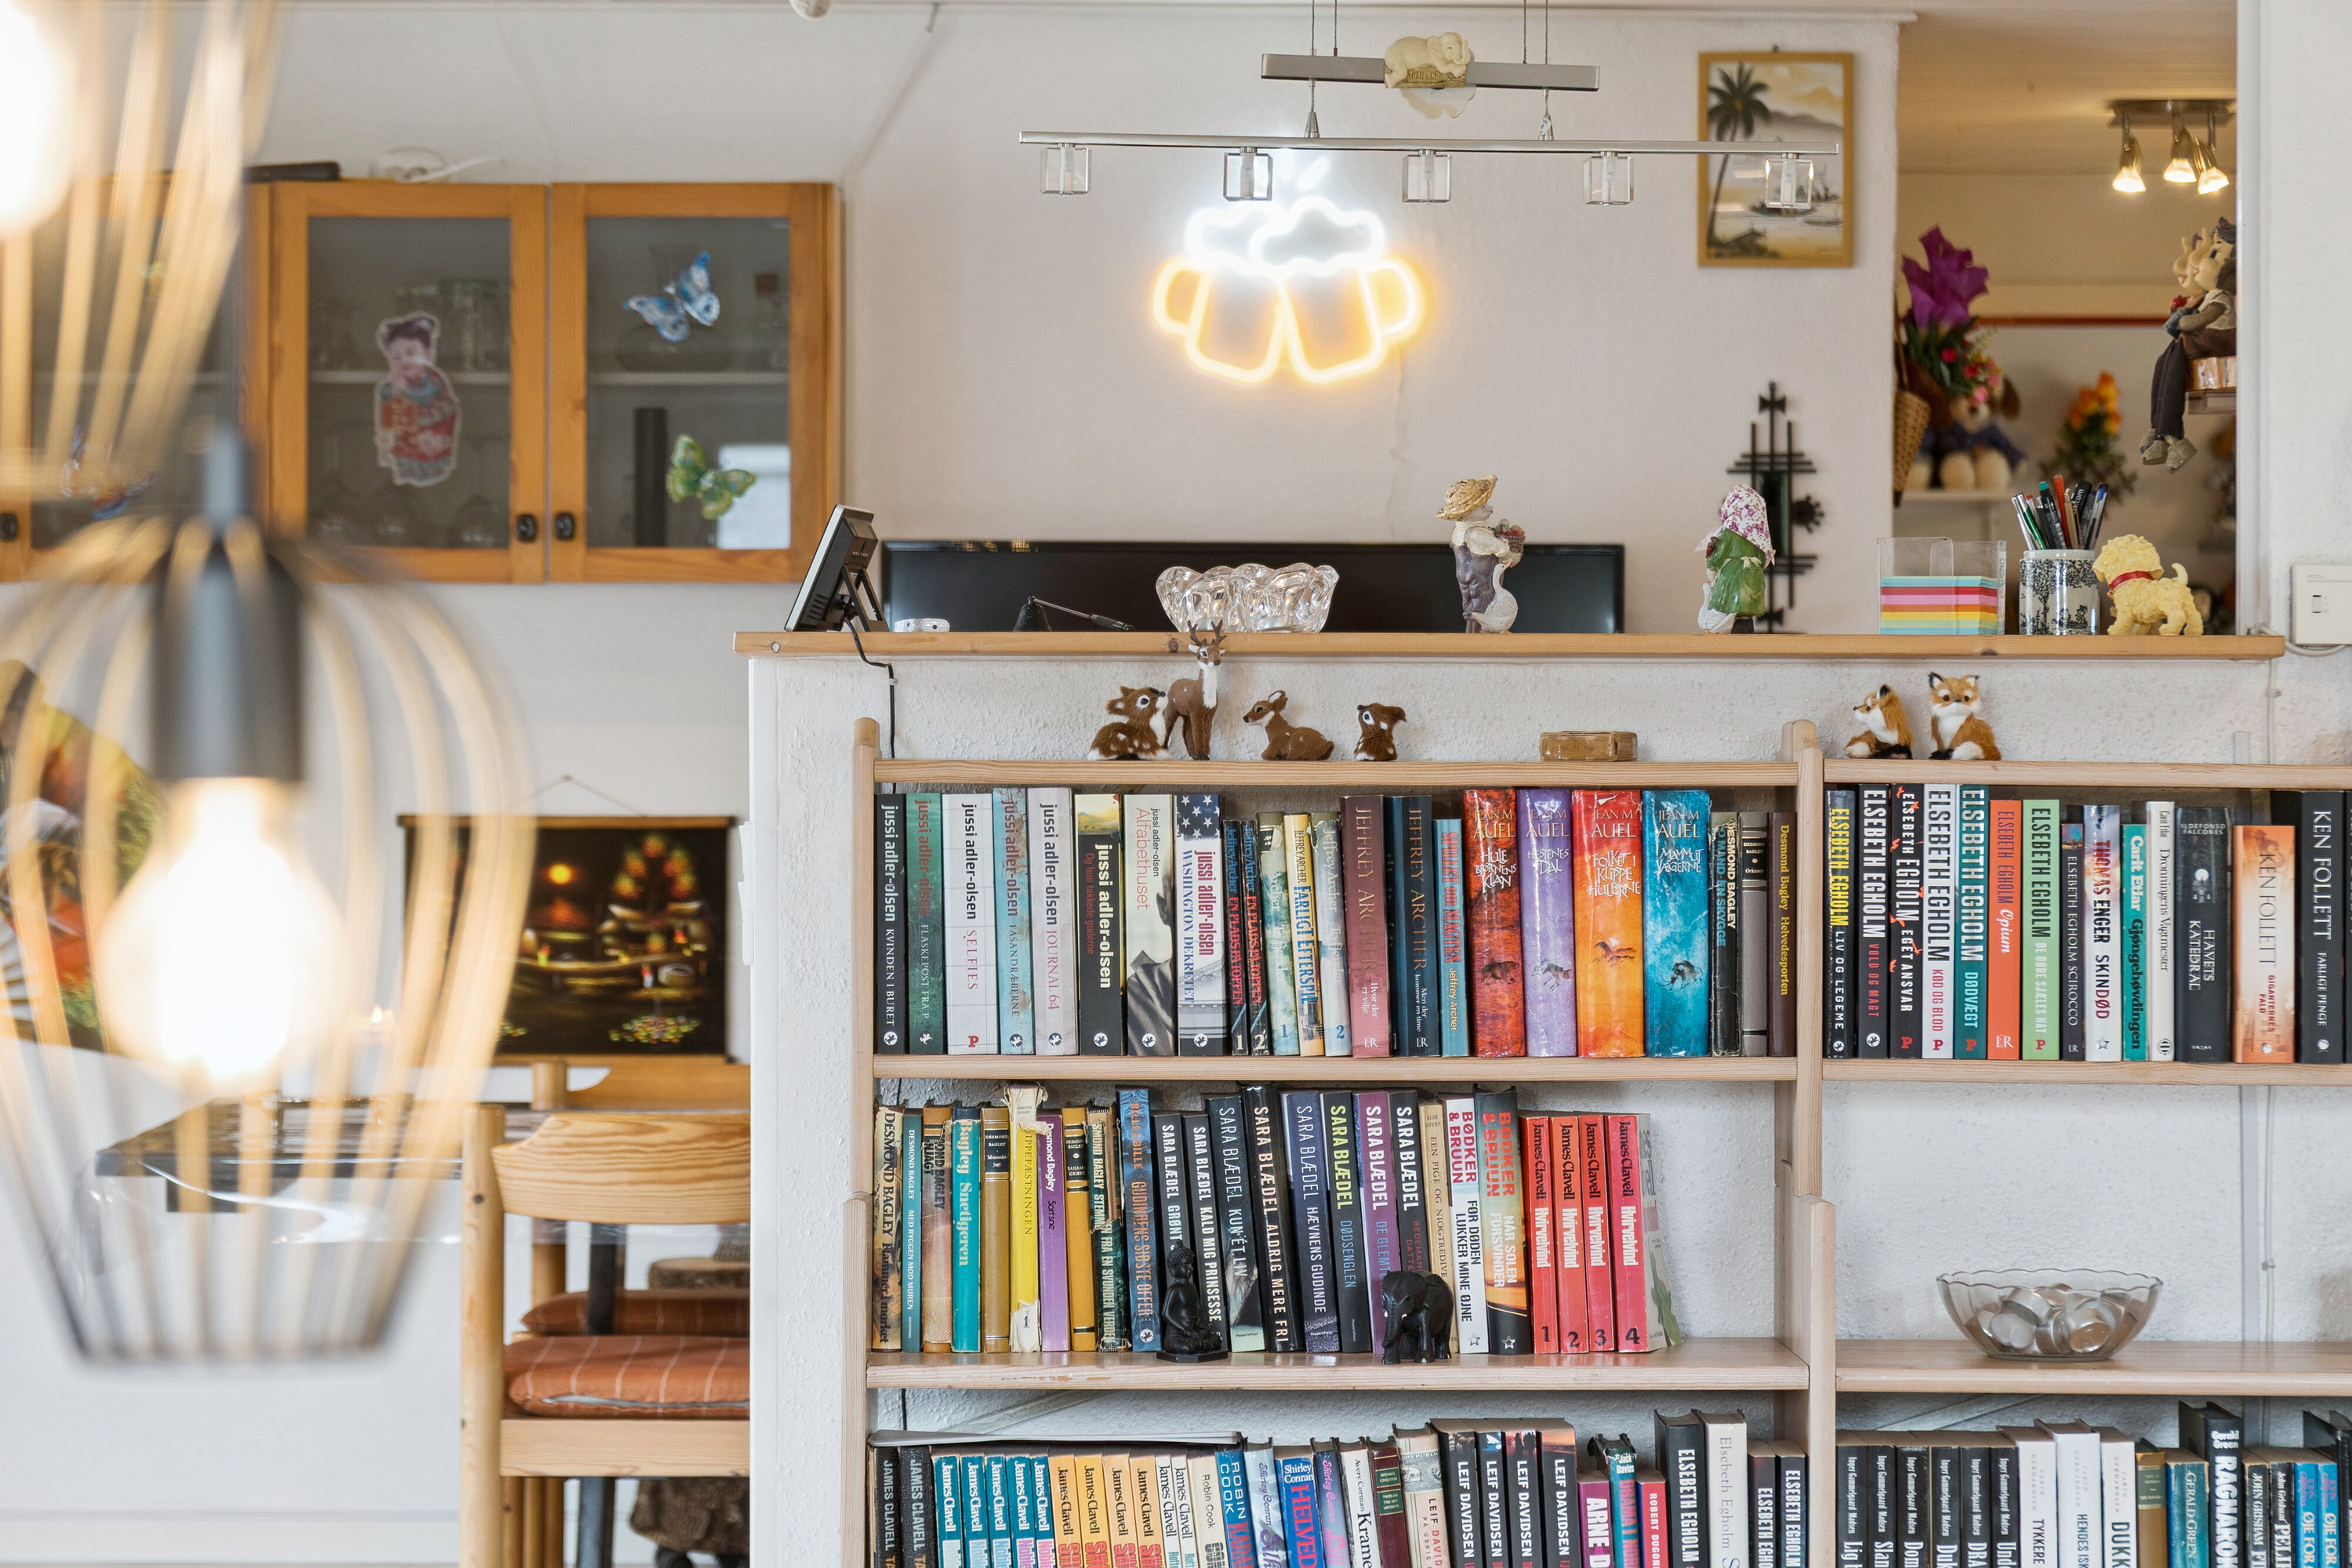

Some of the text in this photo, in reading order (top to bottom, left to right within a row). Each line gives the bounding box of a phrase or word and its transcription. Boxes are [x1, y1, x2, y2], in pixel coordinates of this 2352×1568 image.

[915, 800, 933, 916] jussi adler-olsen
[1137, 808, 1151, 909] Alfabethuset
[1474, 823, 1515, 839] AUEL
[1481, 847, 1508, 864] HULE
[1526, 822, 1569, 837] AUEL
[1527, 848, 1569, 859] HESTENES
[1592, 823, 1636, 838] AUEL
[1657, 824, 1701, 838] AUEL
[1660, 848, 1704, 862] MAMMUT
[1902, 793, 1915, 854] ELSEBETH
[881, 804, 898, 921] jussi adler-olsen
[962, 804, 978, 919] jussi adler-olsen
[1475, 863, 1516, 877] BJØRNENS
[1483, 873, 1512, 893] KLAN
[1587, 881, 1642, 898] HULERNE
[1726, 822, 1736, 928] DESMOND BAGLEY
[1831, 808, 1849, 926] ELSEBETH EGHOLM
[1863, 790, 1886, 938] ELSEBETH EGHOLM
[1896, 859, 1920, 920] EGHOLM
[1928, 790, 1951, 961] ELSEBETH EGHOLM
[1961, 789, 1984, 961] ELSEBETH EGHOLM
[2313, 810, 2332, 941] KEN FOLLETT
[1083, 853, 1095, 955] Og hun takkede guderne
[1180, 850, 1195, 1002] WASHINGTON DEKRETET
[1779, 825, 1790, 995] Desmond Bagley Helvedesporten
[2093, 840, 2111, 1019] THOMAS ENGER SKINDØD
[2259, 853, 2277, 967] KEN FOLLETT
[967, 930, 978, 989] SELFIES
[1010, 925, 1019, 1016] FASANDRÆBERNE
[1046, 930, 1060, 1010] JOURNAL 64
[1294, 885, 1319, 1005] FARLIGT EFTERSPIL
[1835, 931, 1844, 1029] LIV OG LEGEME
[1901, 930, 1913, 1011] EGET ANSVAR
[2189, 920, 2201, 991] KATEDRAL
[2204, 930, 2215, 982] HAVETS
[1449, 967, 1458, 999] Jeffrey
[1868, 944, 1879, 1018] VOLD OG MAGT
[1933, 970, 1944, 1032] KØD OG BLOD
[1965, 972, 1978, 1029] DØDVÆGT
[2128, 919, 2143, 1050] Gjøngehøvdingen
[2317, 953, 2327, 1026] FARLIGE PENGE
[1236, 1035, 1244, 1050] 1
[1254, 1034, 1265, 1050] 2
[1336, 1025, 1345, 1039] 2
[1045, 1123, 1055, 1192] Desmond Bagley
[1297, 1105, 1314, 1142] SARA
[1449, 1112, 1465, 1183] & BRUUN
[1462, 1111, 1478, 1182] BØDKER
[1498, 1112, 1516, 1196] BØDKER
[882, 1112, 895, 1237] DESMOND BAGLEY
[953, 1122, 973, 1267] Bagley Snetigeren
[1162, 1125, 1179, 1199] SARA BLÆDEL
[1300, 1147, 1319, 1200] BLÆDEL
[1530, 1123, 1551, 1269] James Clavell Hvirvelvind
[1559, 1123, 1580, 1269] James Clavell Hvirvelvind
[1618, 1120, 1639, 1266] James Clavell Hvirvelvind
[1193, 1127, 1221, 1322] SARA BLÆDEL KALD MIG PRINSESSE
[1254, 1107, 1288, 1342] SARA BLÆDEL ALDRIG MERE FRI
[1306, 1207, 1322, 1261] HÆVNENS
[1340, 1220, 1356, 1288] DØDSENGLEN
[1468, 1200, 1482, 1265] FØR DØDEN
[1490, 1212, 1505, 1288] FORSVINDER
[1311, 1265, 1327, 1313] GUDINDE
[1455, 1213, 1472, 1322] LUKKER MINE ØJNE
[1541, 1326, 1550, 1342] 1
[1568, 1331, 1580, 1348] 2
[1595, 1329, 1607, 1346] 3
[1626, 1327, 1640, 1345] 4
[2211, 1431, 2239, 1440] Gerald
[2213, 1440, 2238, 1449] Green
[884, 1460, 895, 1550] JAMES CLAVELL
[909, 1459, 925, 1551] JAMES CLAVELL
[942, 1462, 956, 1532] James Clavell
[1034, 1461, 1050, 1531] James Clavell
[1221, 1464, 1234, 1514] COOK
[1231, 1461, 1246, 1519] ROBIN
[1458, 1461, 1475, 1558] LEIF DAVIDSEN
[1486, 1461, 1502, 1557] LEIF DAVIDSEN
[1517, 1461, 1533, 1557] LEIF DAVIDSEN
[1586, 1497, 1610, 1548] ARNE
[1649, 1493, 1660, 1530] ROBERT
[1678, 1449, 1700, 1563] ELSEBETH EGHOLM
[1719, 1436, 1733, 1548] Elsebeth Egholm
[1784, 1470, 1801, 1566] ELSEBETH EGHOLM
[2185, 1471, 2197, 1559] GERALD GREEN
[2032, 1519, 2045, 1565] TYKKERE
[2077, 1514, 2089, 1548] HENDES
